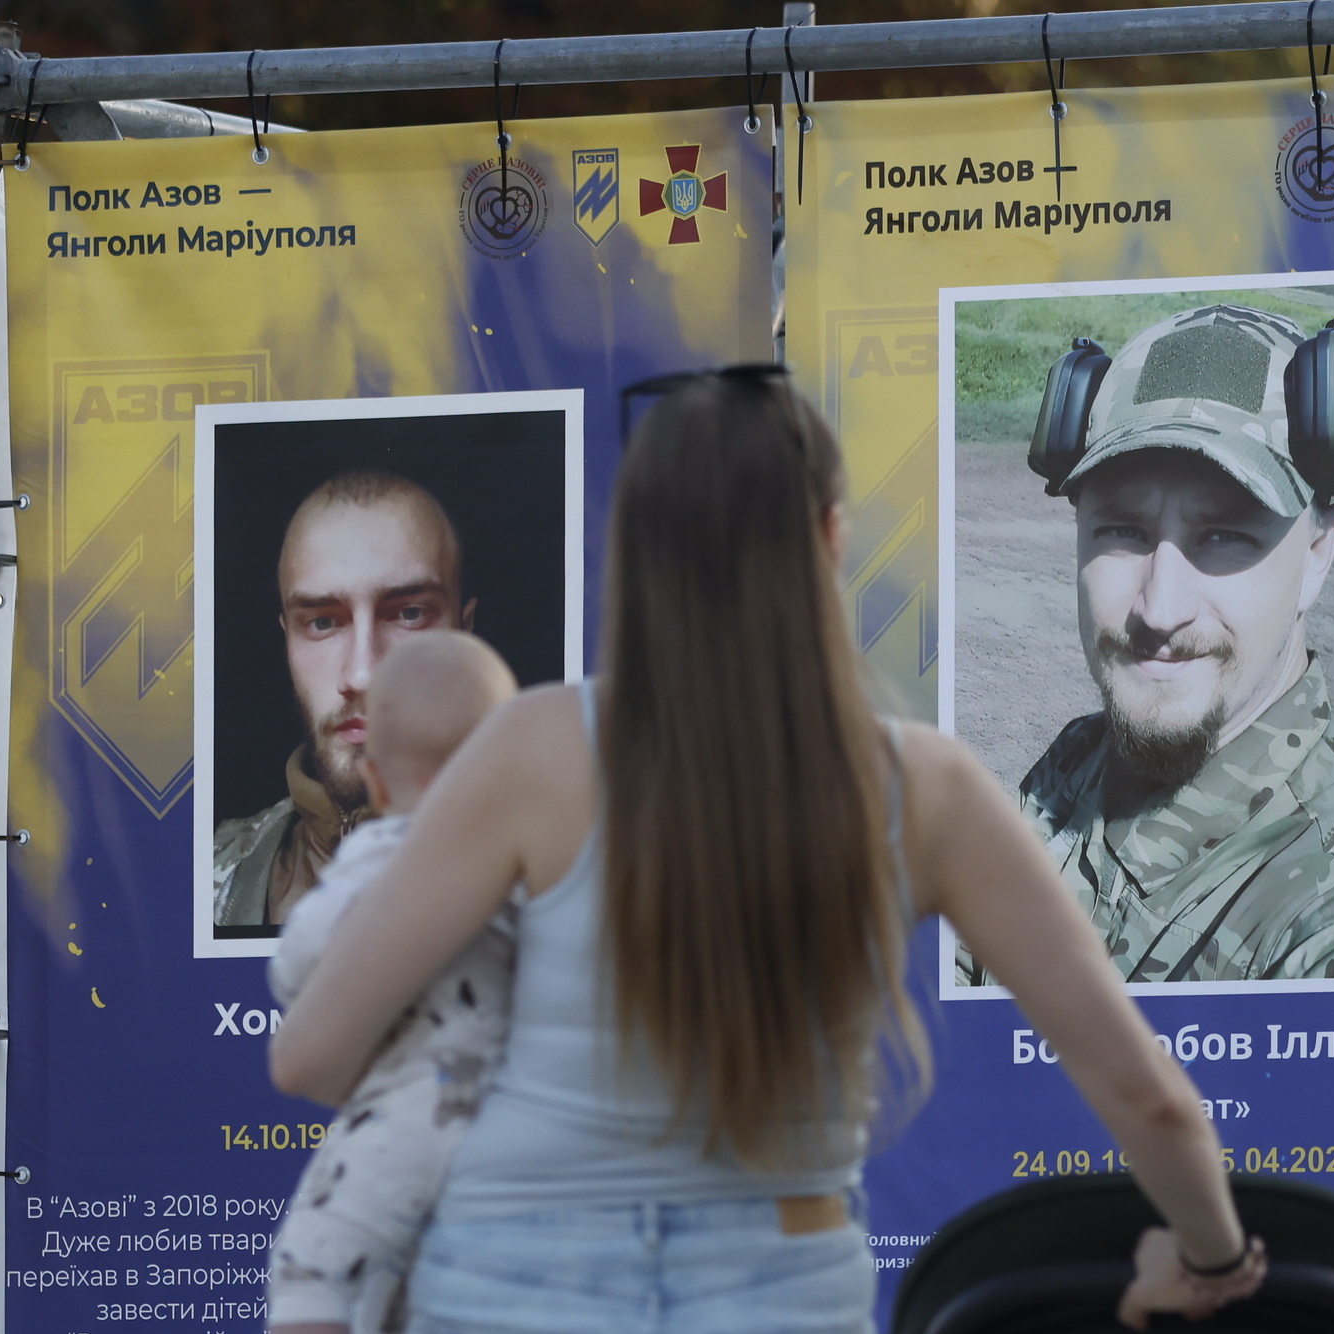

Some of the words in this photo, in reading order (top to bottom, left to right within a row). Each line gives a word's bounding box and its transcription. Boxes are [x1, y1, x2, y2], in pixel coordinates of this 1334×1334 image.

[1278, 116, 1313, 151] СЕРЦЕ
[577, 154, 615, 165] АЗОВ
[866, 162, 947, 189] Полк
[956, 158, 1034, 185] Азов
[49, 186, 130, 211] Полк
[140, 182, 221, 208] Азов
[864, 207, 982, 235] Янголи
[995, 200, 1170, 234] Маріуполя
[48, 232, 165, 258] Янголи
[178, 220, 355, 257] Маріуполя
[848, 333, 938, 378] АЗ
[1013, 1024, 1253, 1064] Бообов
[1012, 1150, 1133, 1177] 24.09.19
[28, 1198, 42, 1218] В
[144, 1201, 155, 1216] з
[163, 1195, 217, 1216] 2018
[226, 1199, 288, 1224] року.
[42, 1232, 110, 1257] Дуже
[117, 1229, 202, 1251] любив
[8, 1265, 117, 1292] переїхав
[127, 1270, 138, 1285] в
[97, 1303, 194, 1320] завести
